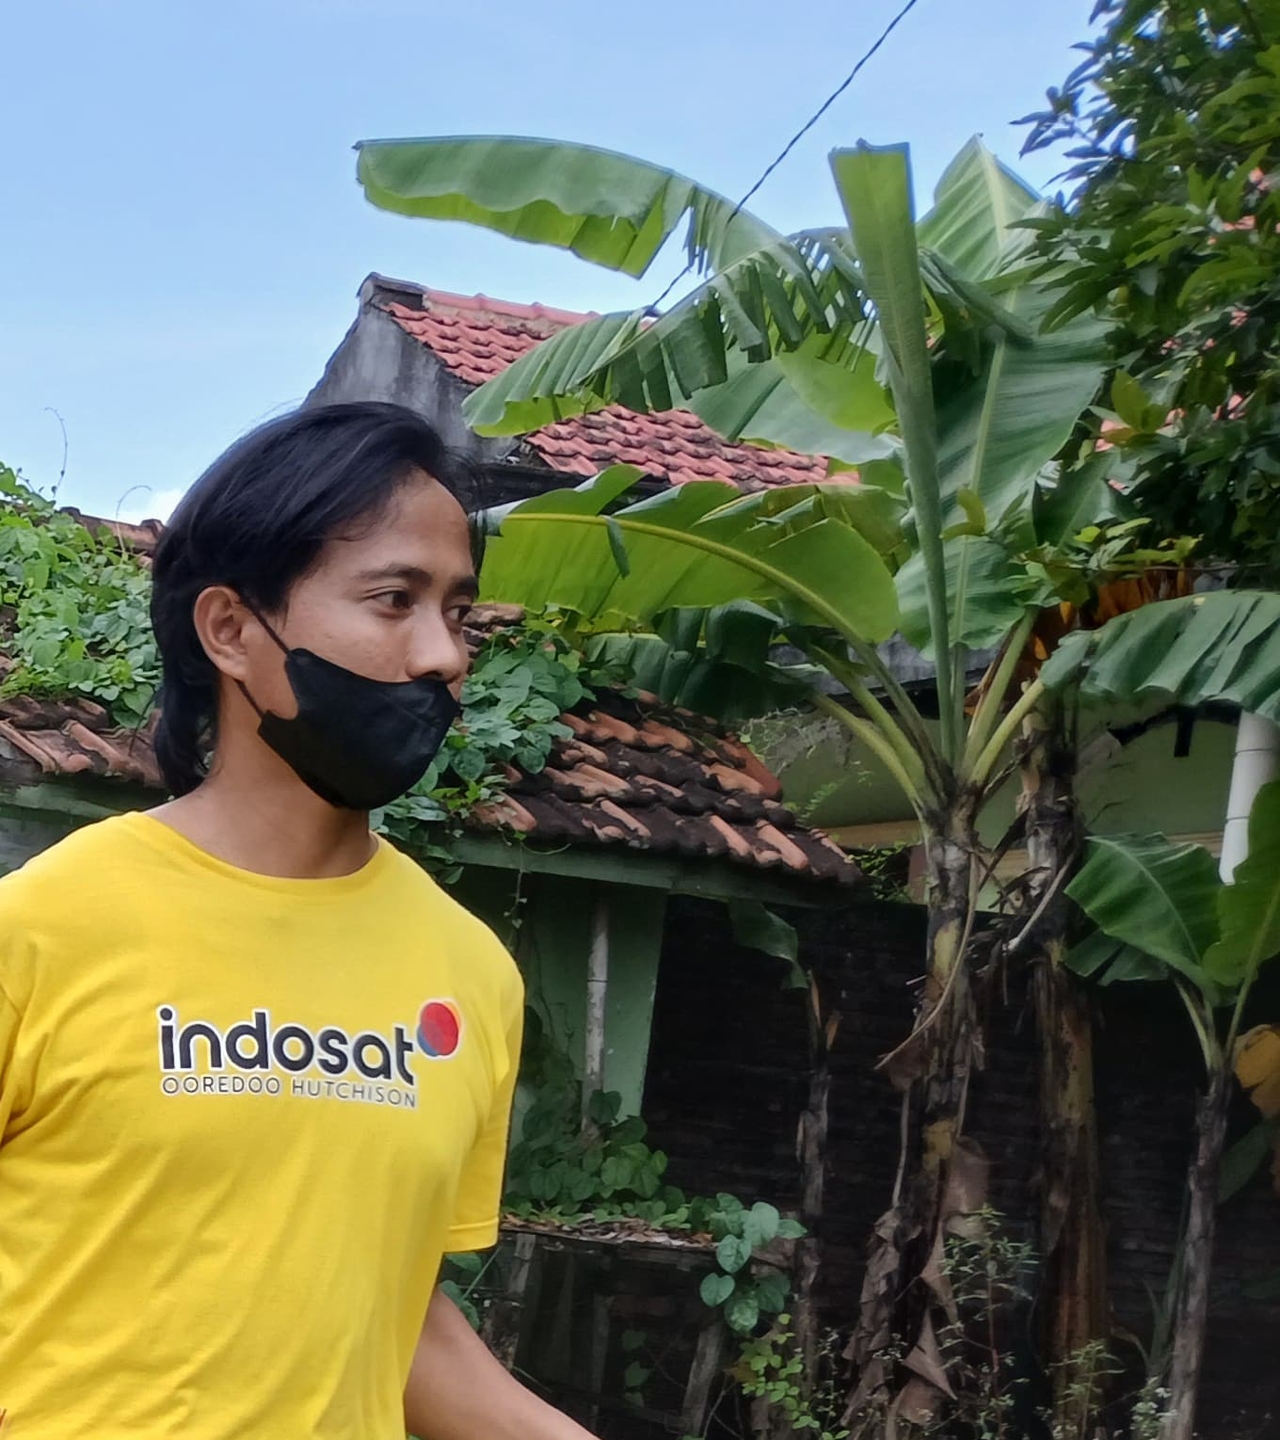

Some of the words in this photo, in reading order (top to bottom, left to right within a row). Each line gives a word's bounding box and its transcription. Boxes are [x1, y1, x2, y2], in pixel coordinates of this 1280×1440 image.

[158, 1006, 416, 1087] indosat
[161, 1075, 282, 1096] OOREDOO
[291, 1078, 417, 1109] HUTCHISON
